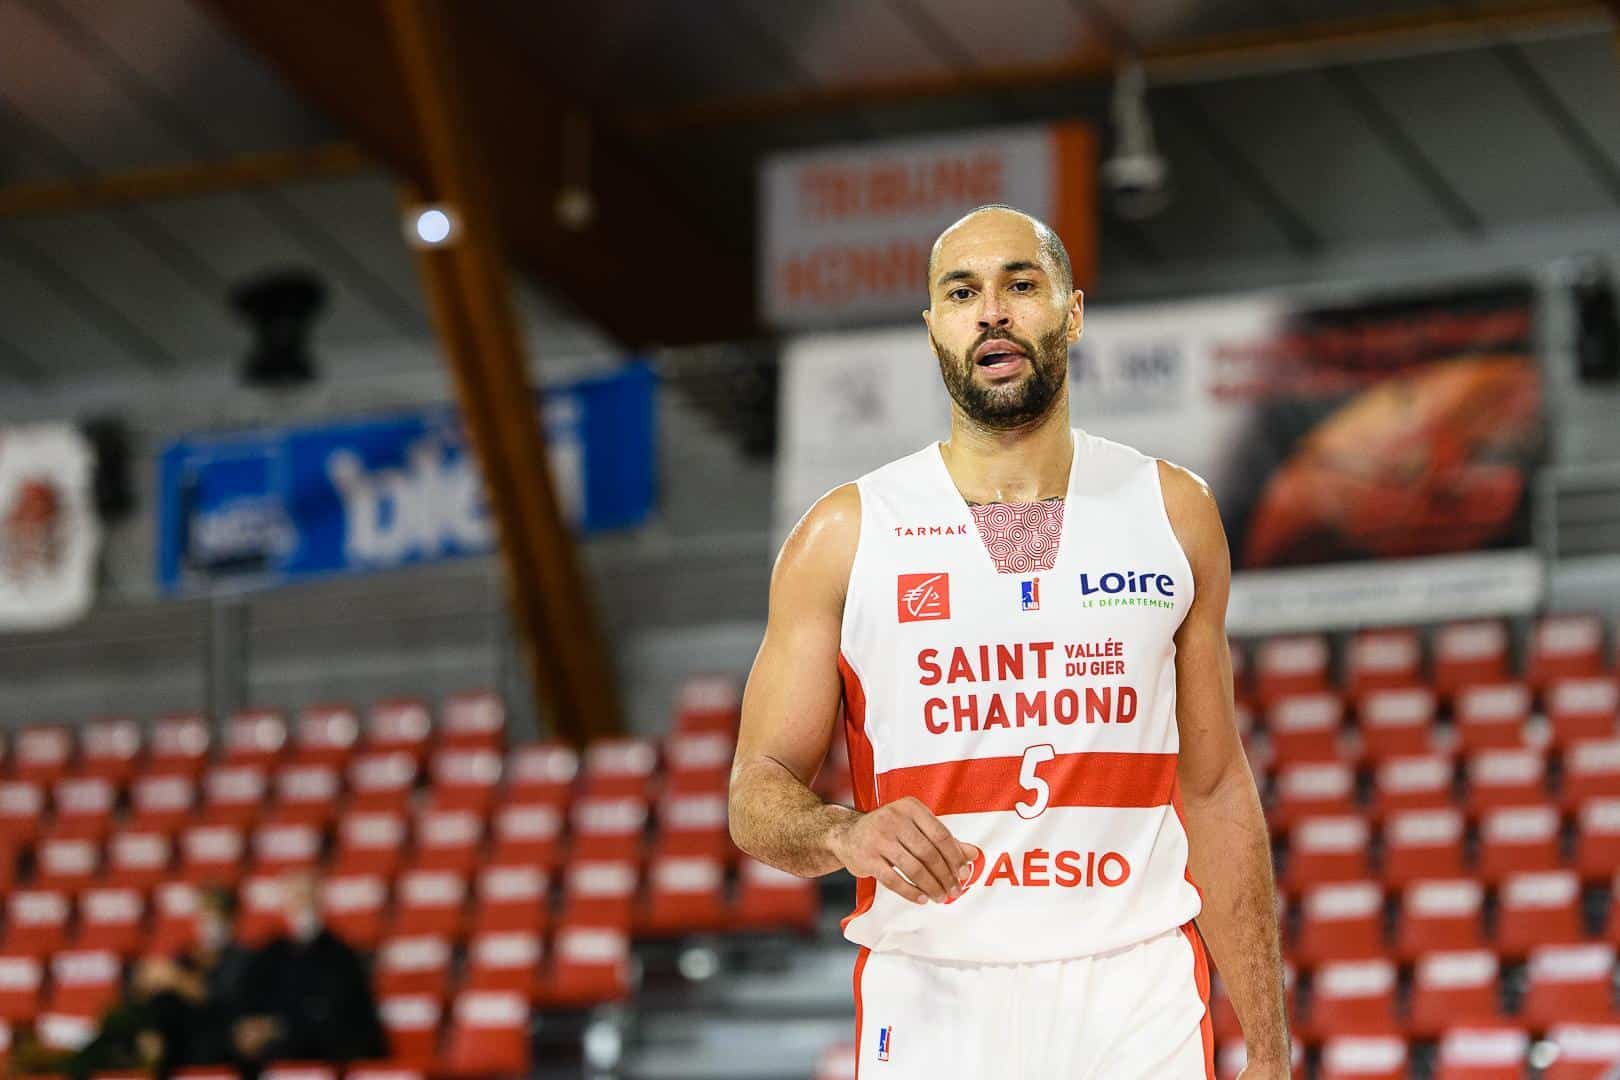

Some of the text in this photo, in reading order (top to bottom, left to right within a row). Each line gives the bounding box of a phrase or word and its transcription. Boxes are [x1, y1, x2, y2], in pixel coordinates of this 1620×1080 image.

[895, 524, 968, 537] TARMAK
[1082, 597, 1175, 609] LE DÉPARTEMENT
[917, 641, 1055, 686] SAINT
[1064, 637, 1124, 659] VALLÉE
[1065, 660, 1125, 677] DU GIER
[924, 686, 1138, 735] CHAMOND
[1014, 743, 1056, 820] 5
[985, 848, 1131, 888] AÉSIO
